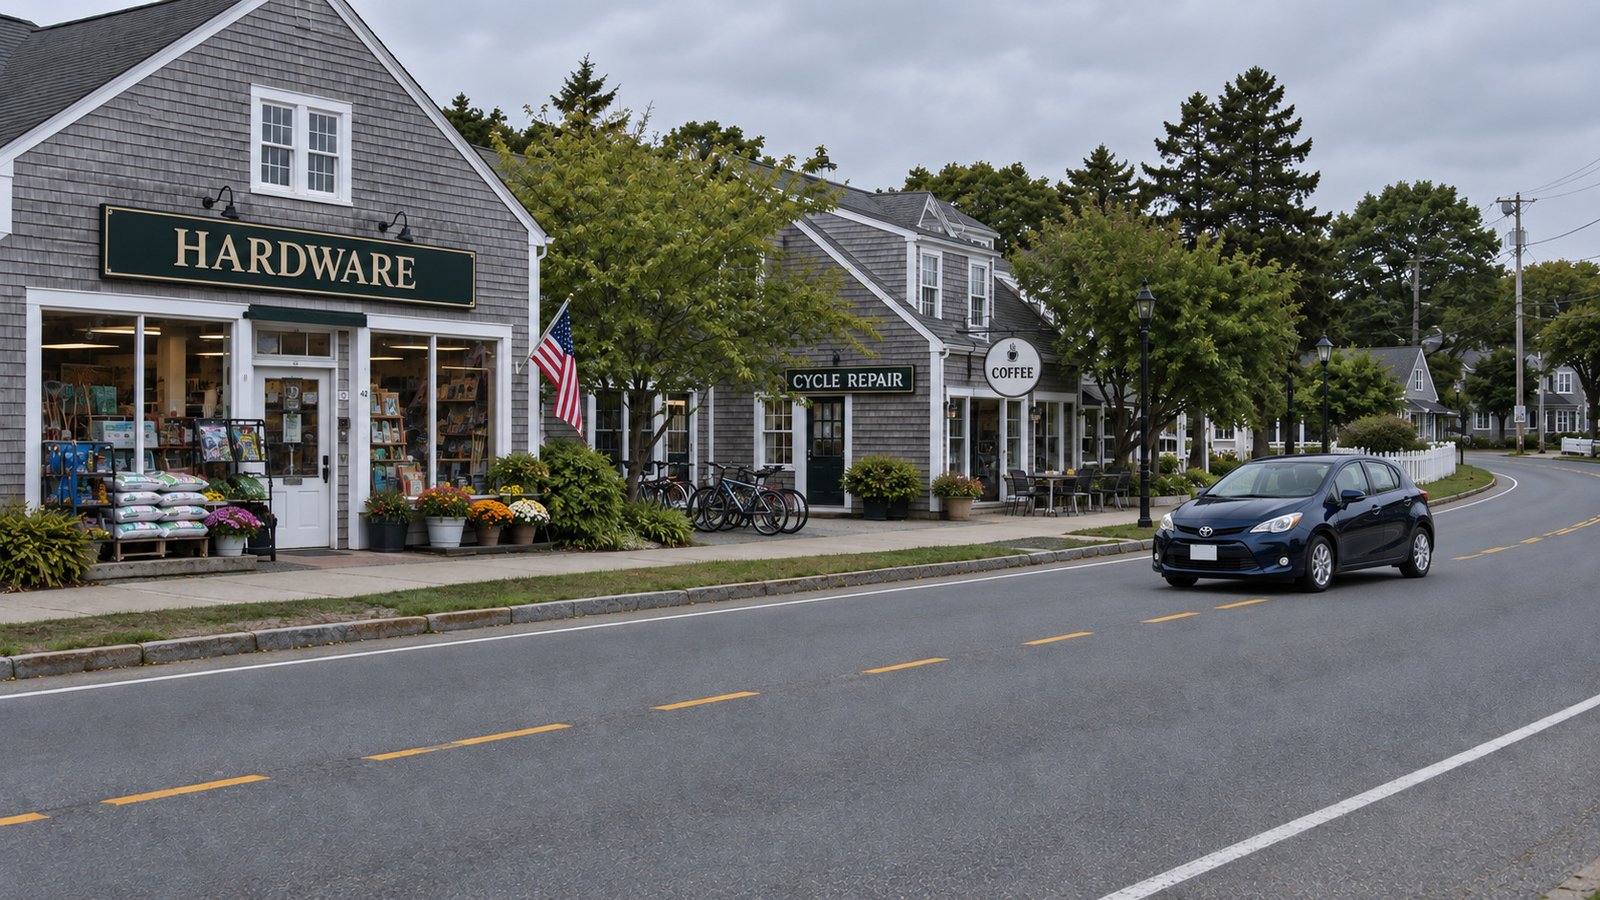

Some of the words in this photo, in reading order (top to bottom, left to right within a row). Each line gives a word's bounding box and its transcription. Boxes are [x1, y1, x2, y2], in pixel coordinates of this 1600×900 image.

[174, 228, 416, 289] HARDWARE
[991, 366, 1034, 379] COFFEE
[793, 373, 841, 388] CYCLE
[848, 372, 903, 388] REPAIR
[360, 390, 369, 398] 42
